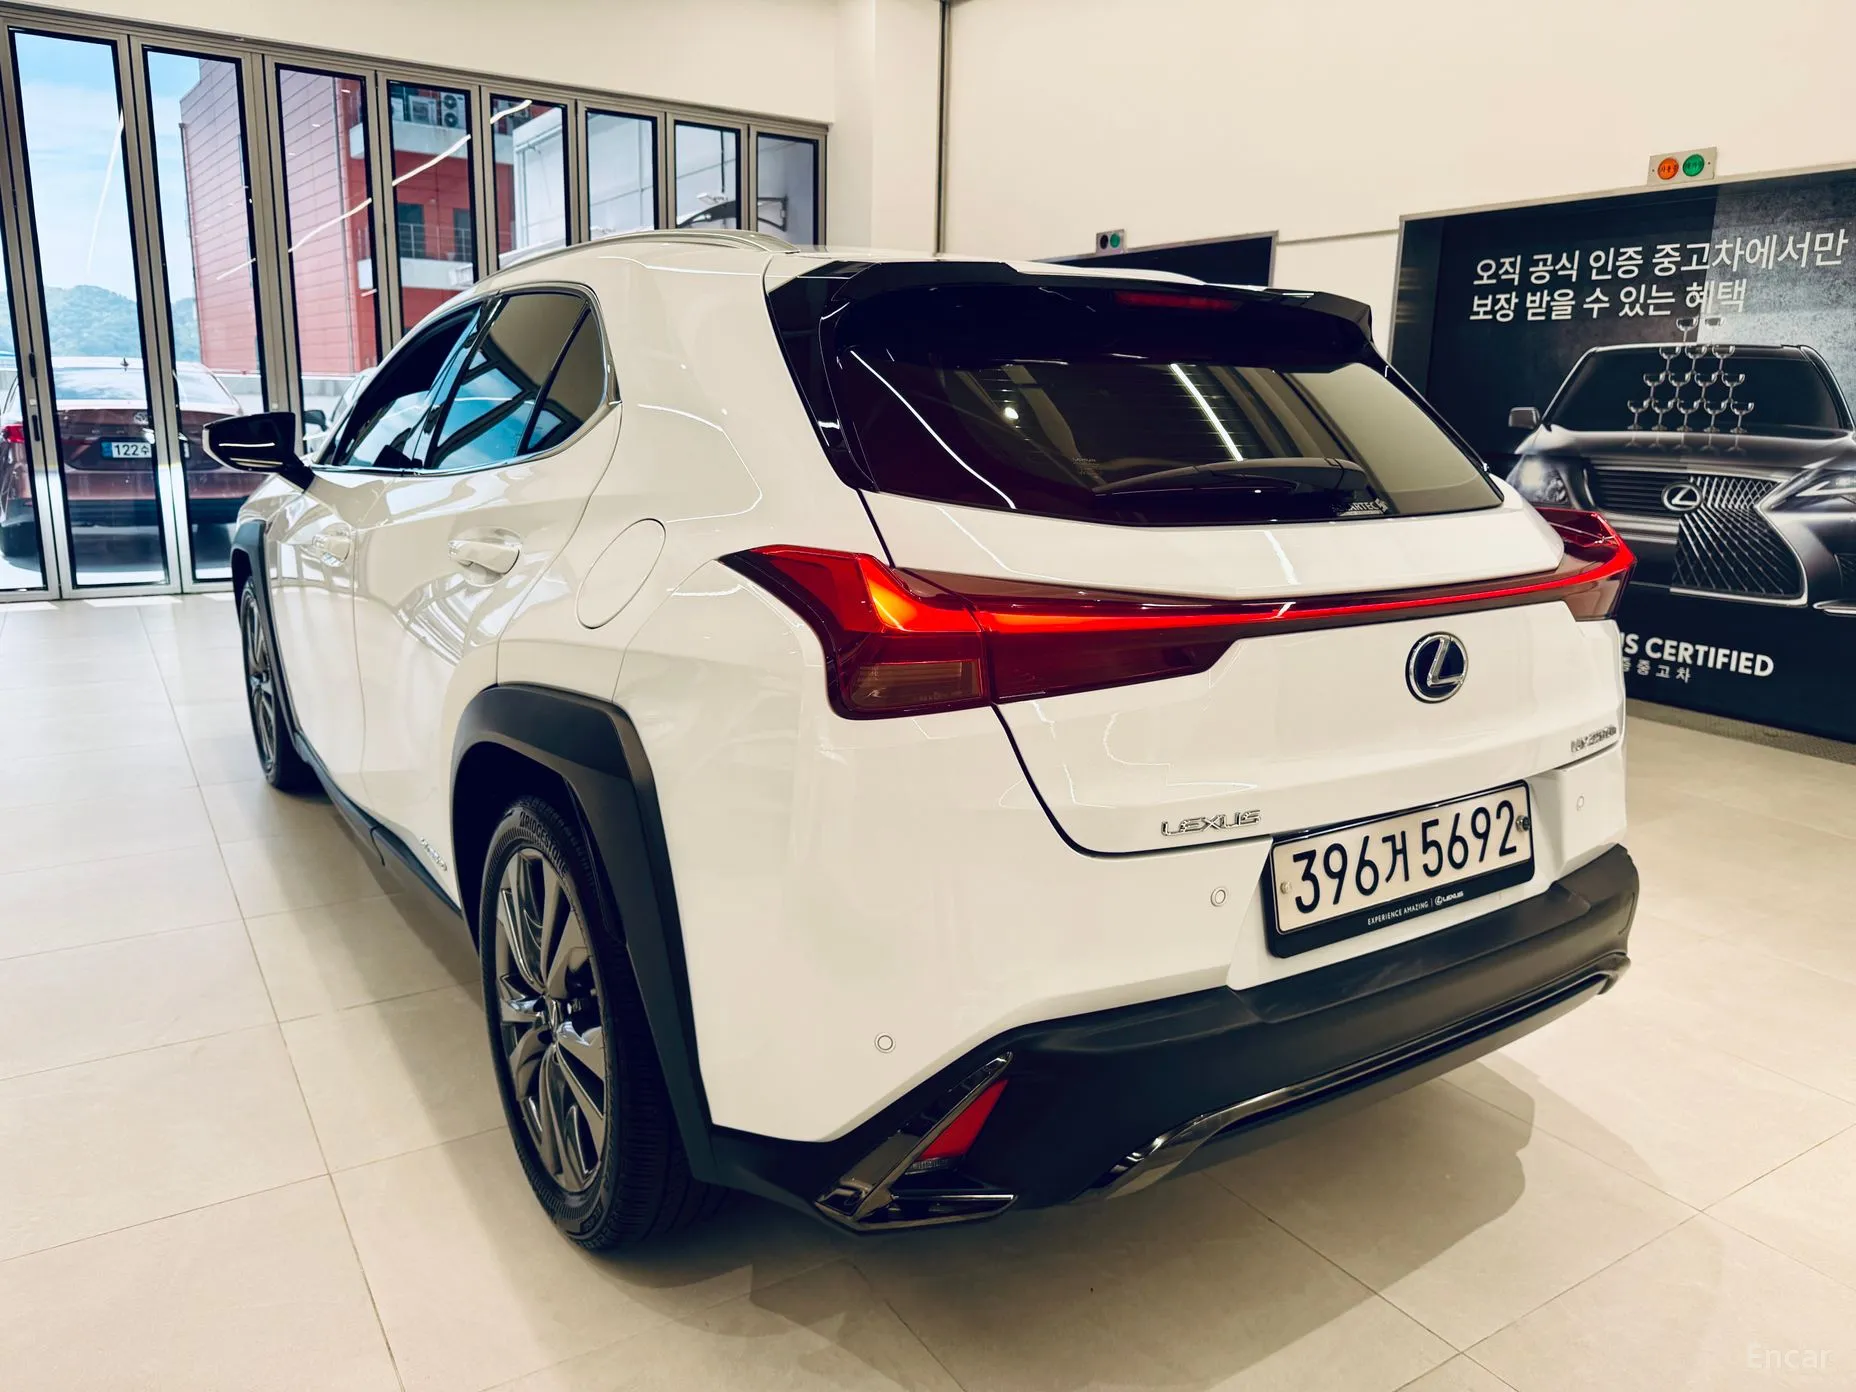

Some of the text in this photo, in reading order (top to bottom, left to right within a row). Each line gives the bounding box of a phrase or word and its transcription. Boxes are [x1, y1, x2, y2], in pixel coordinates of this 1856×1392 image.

[1473, 228, 1849, 286] 오직 공식 인증 중고차에서만
[1469, 278, 1748, 322] 보장 받을 수 있는 혜택
[1645, 637, 1775, 677] CERTIFIED
[1161, 809, 1261, 836] LEXUS
[1292, 800, 1518, 914] 396거 5692
[1367, 908, 1402, 925] EXPERIENCE
[1403, 901, 1429, 915] AMAZING
